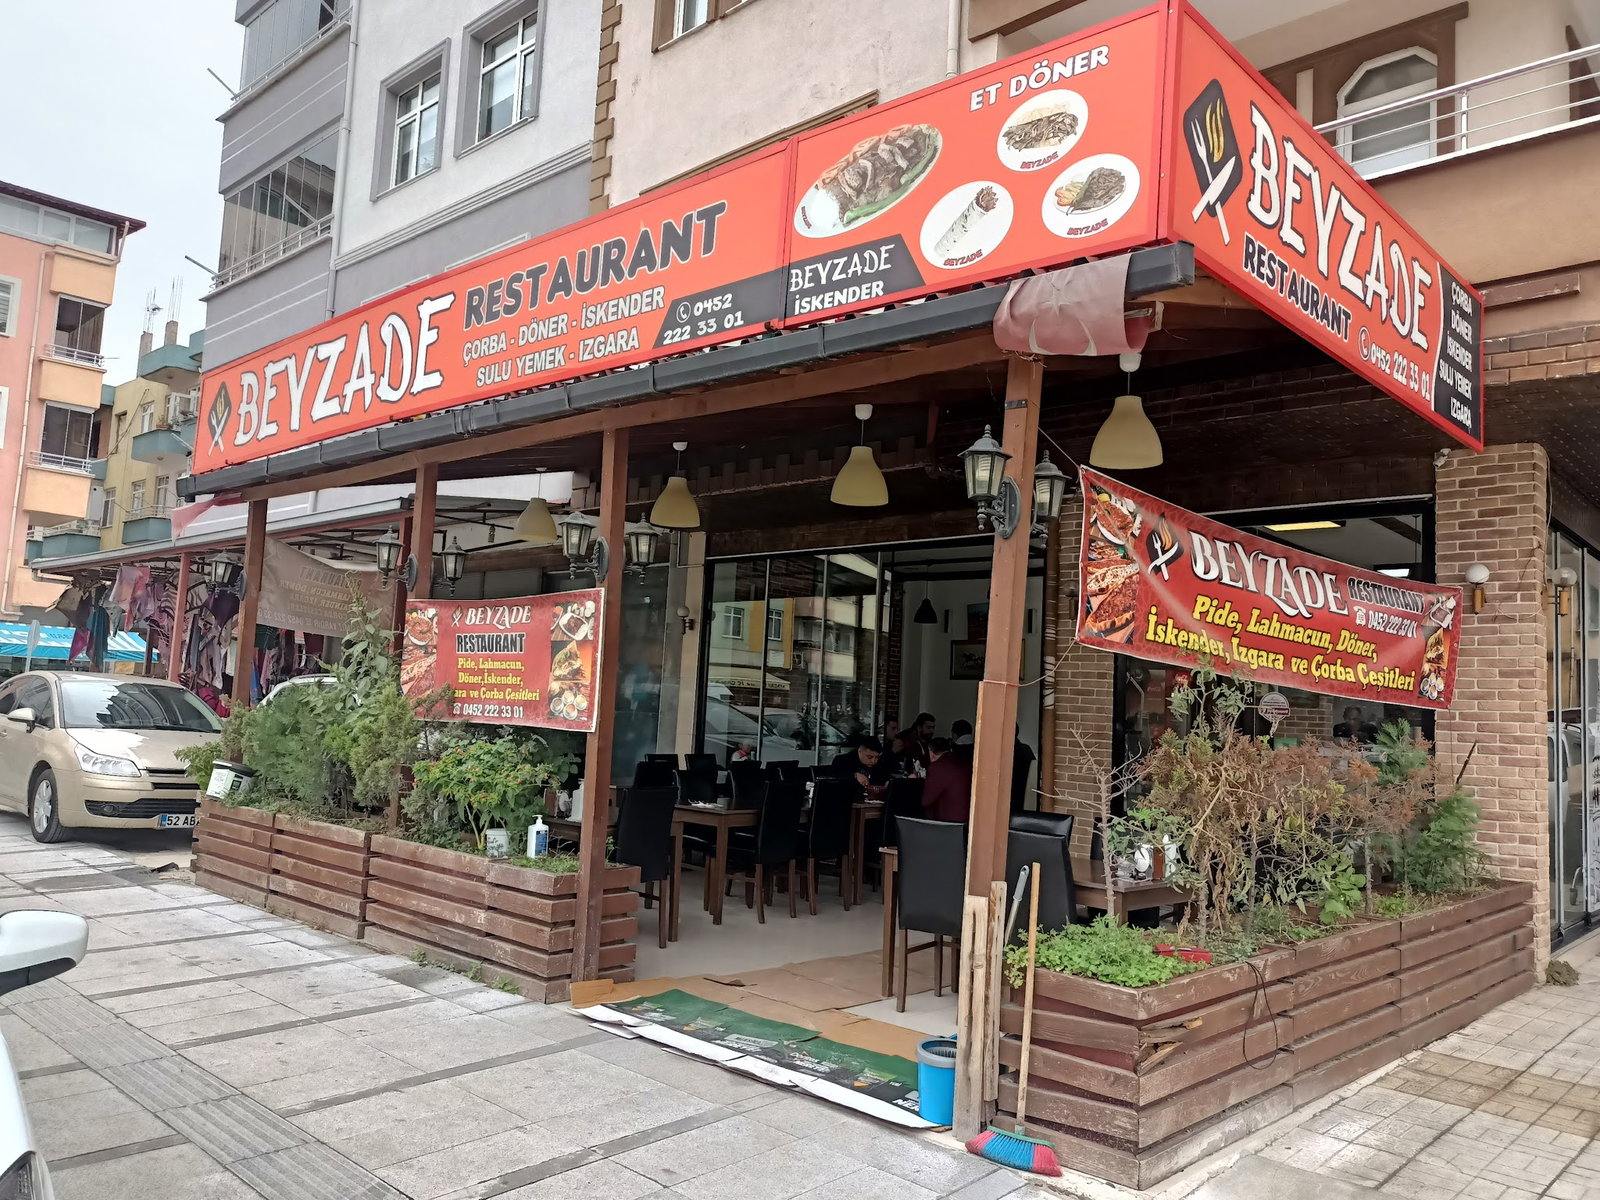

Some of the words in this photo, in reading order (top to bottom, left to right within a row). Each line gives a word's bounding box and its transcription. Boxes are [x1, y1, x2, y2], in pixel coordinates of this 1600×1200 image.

[969, 82, 1002, 112] ET
[1009, 44, 1110, 99] DÖNER
[1020, 151, 1059, 169] BEYZADE
[1067, 218, 1108, 236] BEYZADE
[1247, 100, 1434, 352] BEYZADE
[463, 200, 728, 331] RESTAURANT
[789, 244, 896, 292] BEYZADE
[943, 249, 983, 267] BEYZADE
[693, 293, 733, 316] 0452
[794, 280, 885, 316] İSKENDER
[1242, 232, 1352, 343] RESTAURANT
[1451, 281, 1473, 317] ÇORBA
[463, 331, 507, 367] ÇORBA
[518, 314, 568, 346] DÖNER
[580, 285, 666, 330] İSKENDER
[663, 326, 691, 345] 222
[697, 320, 717, 336] 33
[724, 310, 744, 328] 01
[1451, 309, 1473, 344] DÖNER
[476, 362, 512, 387] SULU
[516, 346, 566, 378] YEMEK
[578, 327, 640, 363] IZGARA
[1446, 330, 1473, 373] İSKENDER
[234, 293, 457, 447] BEYZADE
[1371, 343, 1390, 375] 0452
[1393, 351, 1407, 386] 222
[1409, 361, 1419, 393] 33
[1422, 371, 1430, 401] 01
[1439, 358, 1453, 386] SULU
[1454, 369, 1473, 400] YEMEK
[1450, 396, 1473, 429] IZGARA
[1188, 530, 1349, 619] BEYZADE
[1347, 576, 1425, 615] RESTAURANT
[465, 605, 531, 629] BEYZADE
[1192, 594, 1243, 634] Pide,
[1246, 608, 1333, 653] Lahmacun,
[1336, 630, 1377, 663] Döner,
[1368, 610, 1388, 632] 0452
[1386, 616, 1401, 635] 222
[1399, 618, 1409, 637] 33
[456, 632, 526, 654] RESTAURANT
[1145, 606, 1230, 664] İskender,
[1231, 636, 1284, 669] Izgara
[1291, 657, 1308, 675] ve
[1310, 655, 1355, 683] Çorba
[1356, 662, 1416, 692] Çeşitleri
[457, 657, 478, 671] Pide,
[479, 658, 524, 671] Lahmacun,
[463, 703, 482, 716] 0452
[484, 704, 499, 717] 222
[501, 705, 511, 717] 33
[513, 706, 523, 718] 01
[470, 690, 479, 698] ve
[480, 687, 504, 702] Çorba
[505, 687, 540, 702] Çeşitleri
[166, 815, 180, 826] 52
